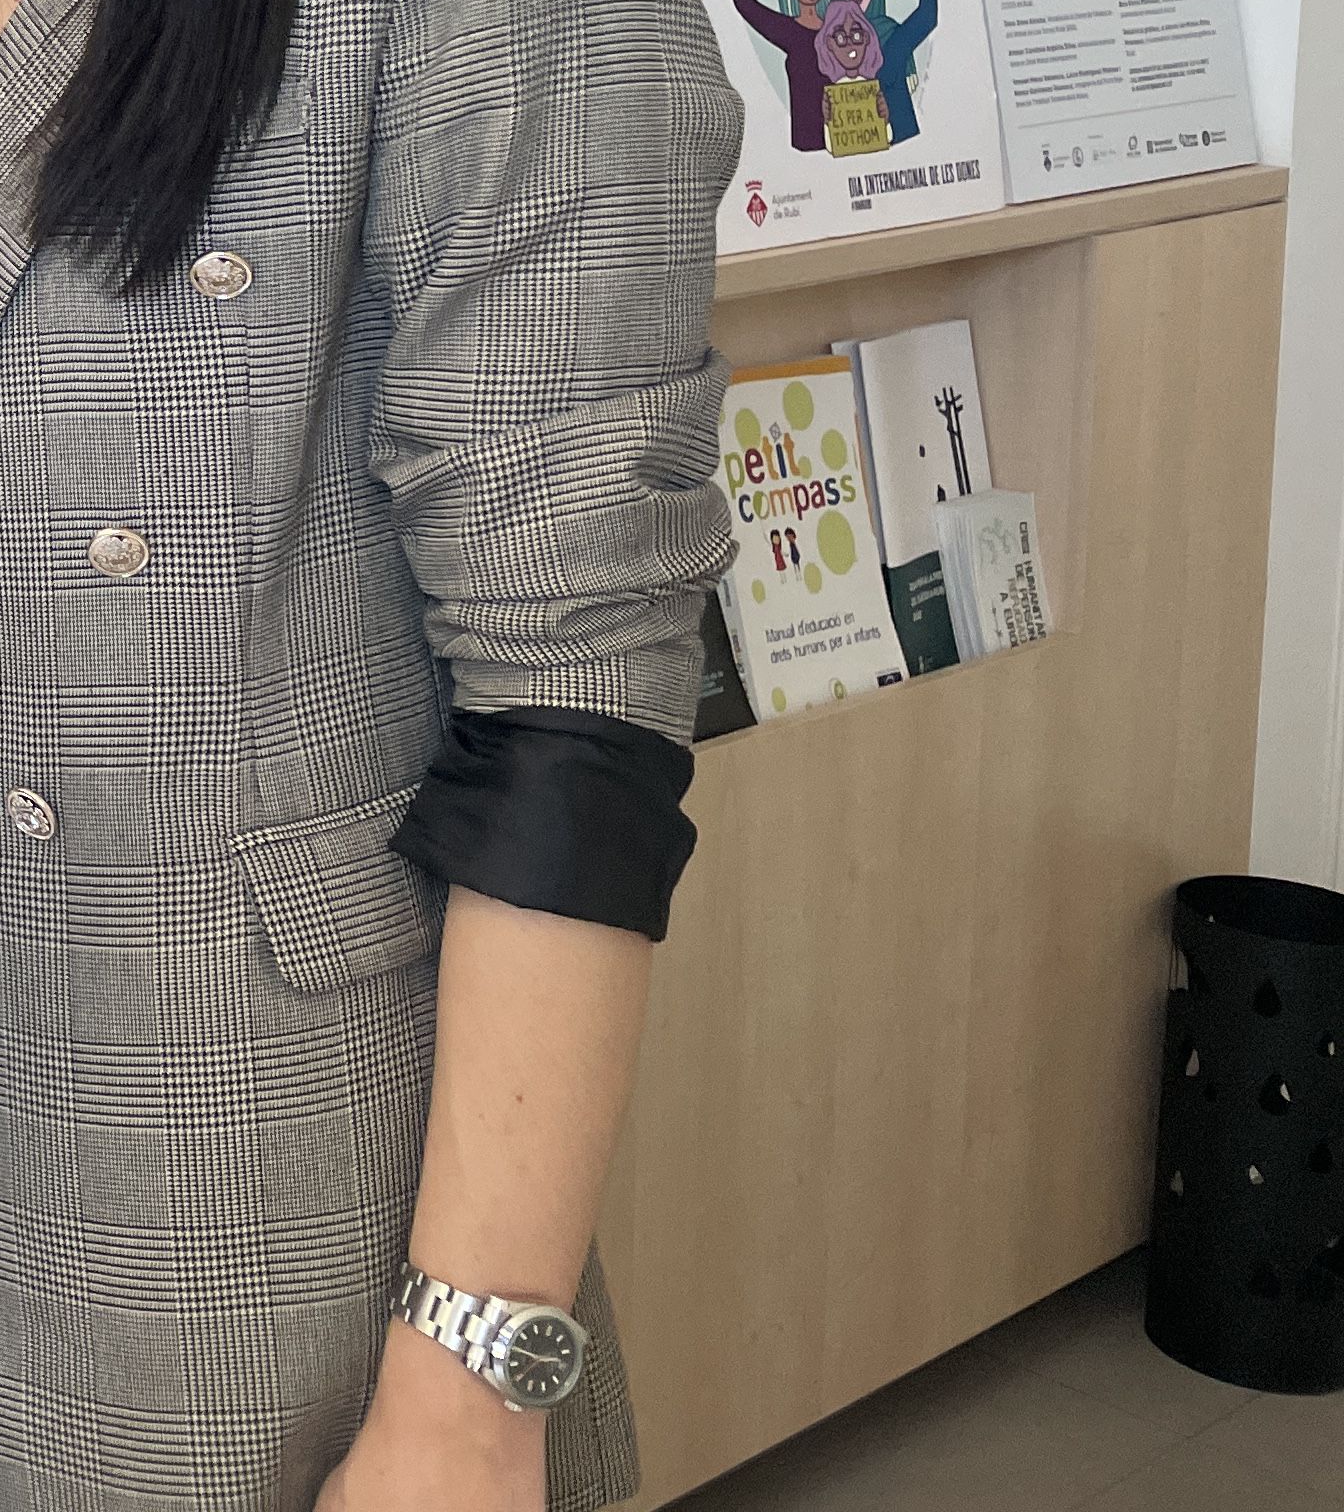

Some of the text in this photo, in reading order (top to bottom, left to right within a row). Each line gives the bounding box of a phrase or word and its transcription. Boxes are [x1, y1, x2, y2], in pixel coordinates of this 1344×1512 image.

[867, 108, 875, 122] A
[833, 126, 881, 147] TOTHOM
[848, 159, 981, 198] DIA INTERNACIONAL DE LES DONES
[723, 426, 801, 500] petit
[738, 473, 857, 524] compass
[765, 622, 795, 644] Manual
